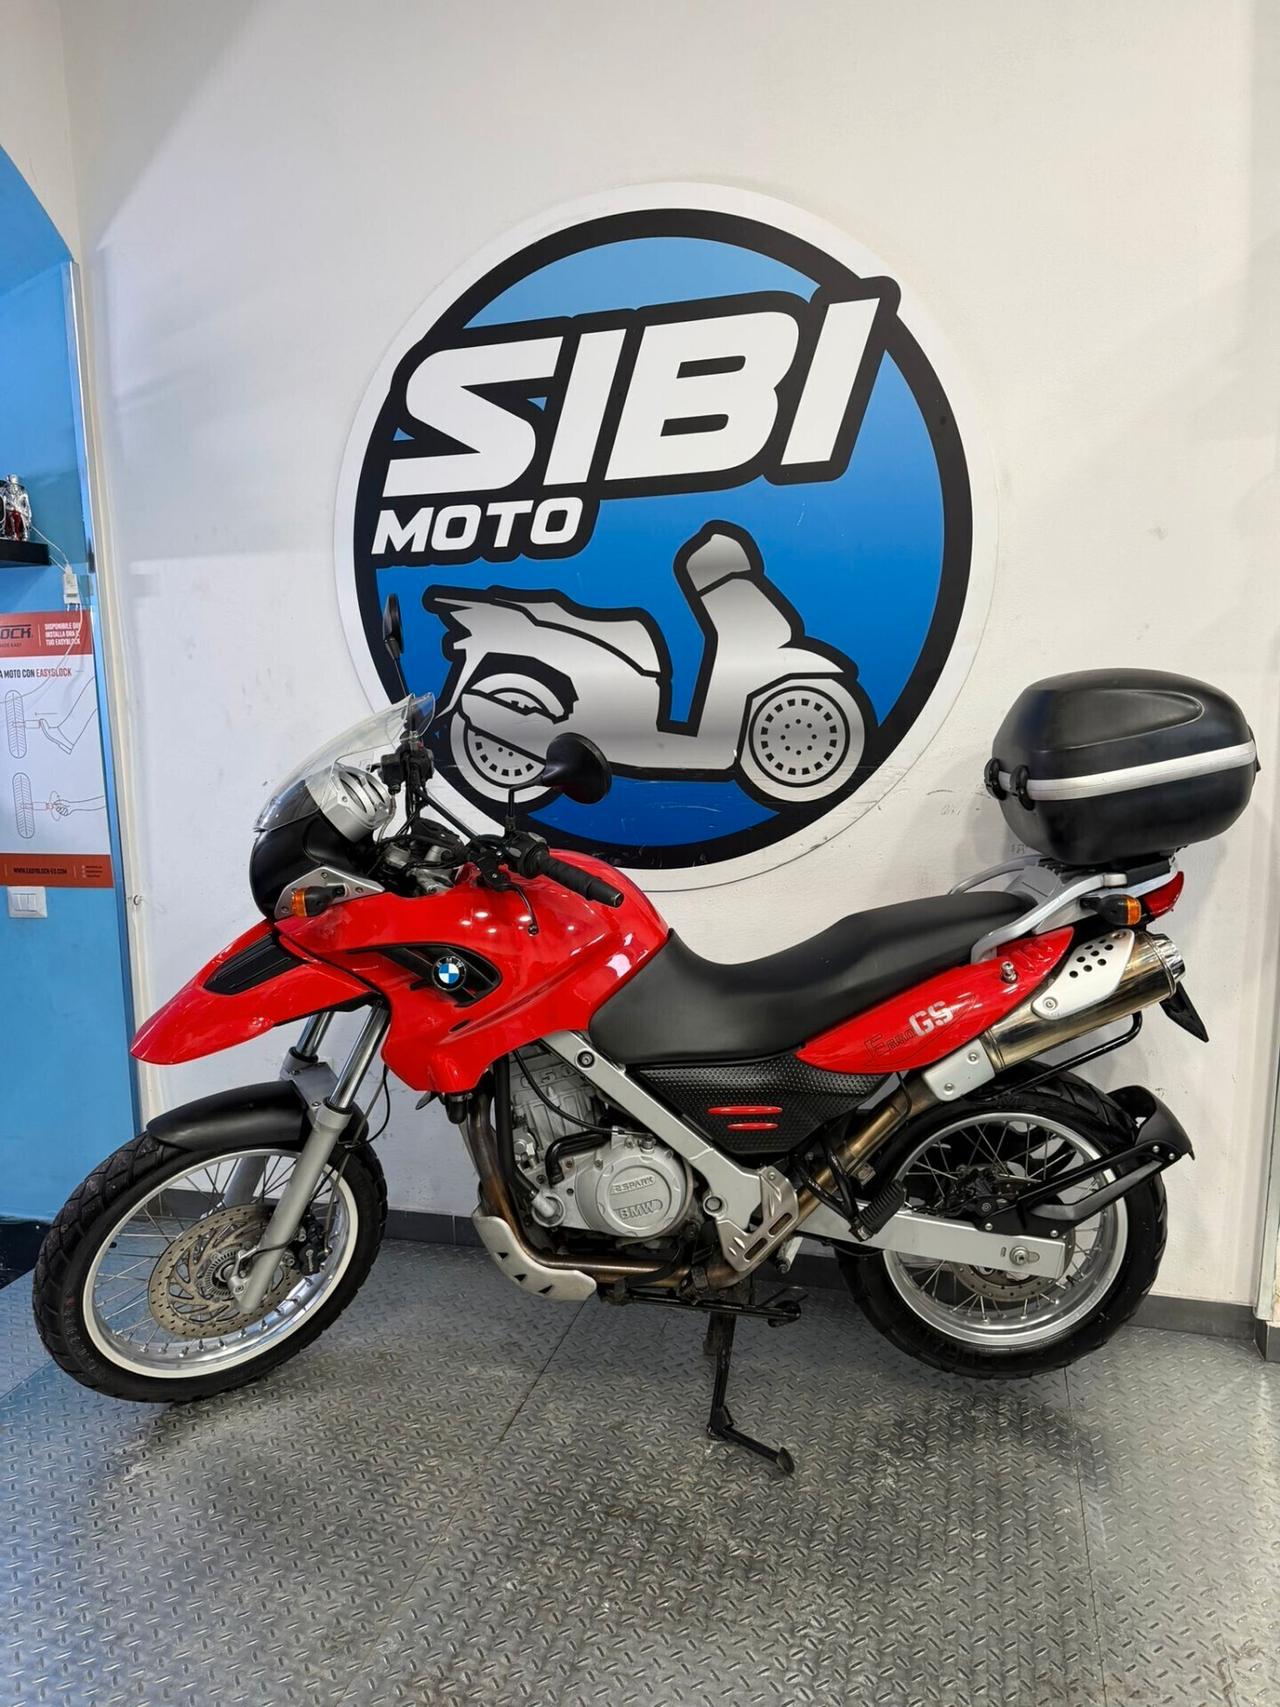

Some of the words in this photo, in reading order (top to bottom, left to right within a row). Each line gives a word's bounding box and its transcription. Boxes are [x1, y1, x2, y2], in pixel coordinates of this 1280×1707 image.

[382, 298, 880, 497] SIBI
[371, 497, 583, 555] MOTO
[4, 669, 21, 679] MOTO
[22, 668, 35, 678] CON
[36, 667, 72, 678] EASYBLOCK
[909, 1000, 953, 1036] GS
[621, 1200, 654, 1219] BMW
